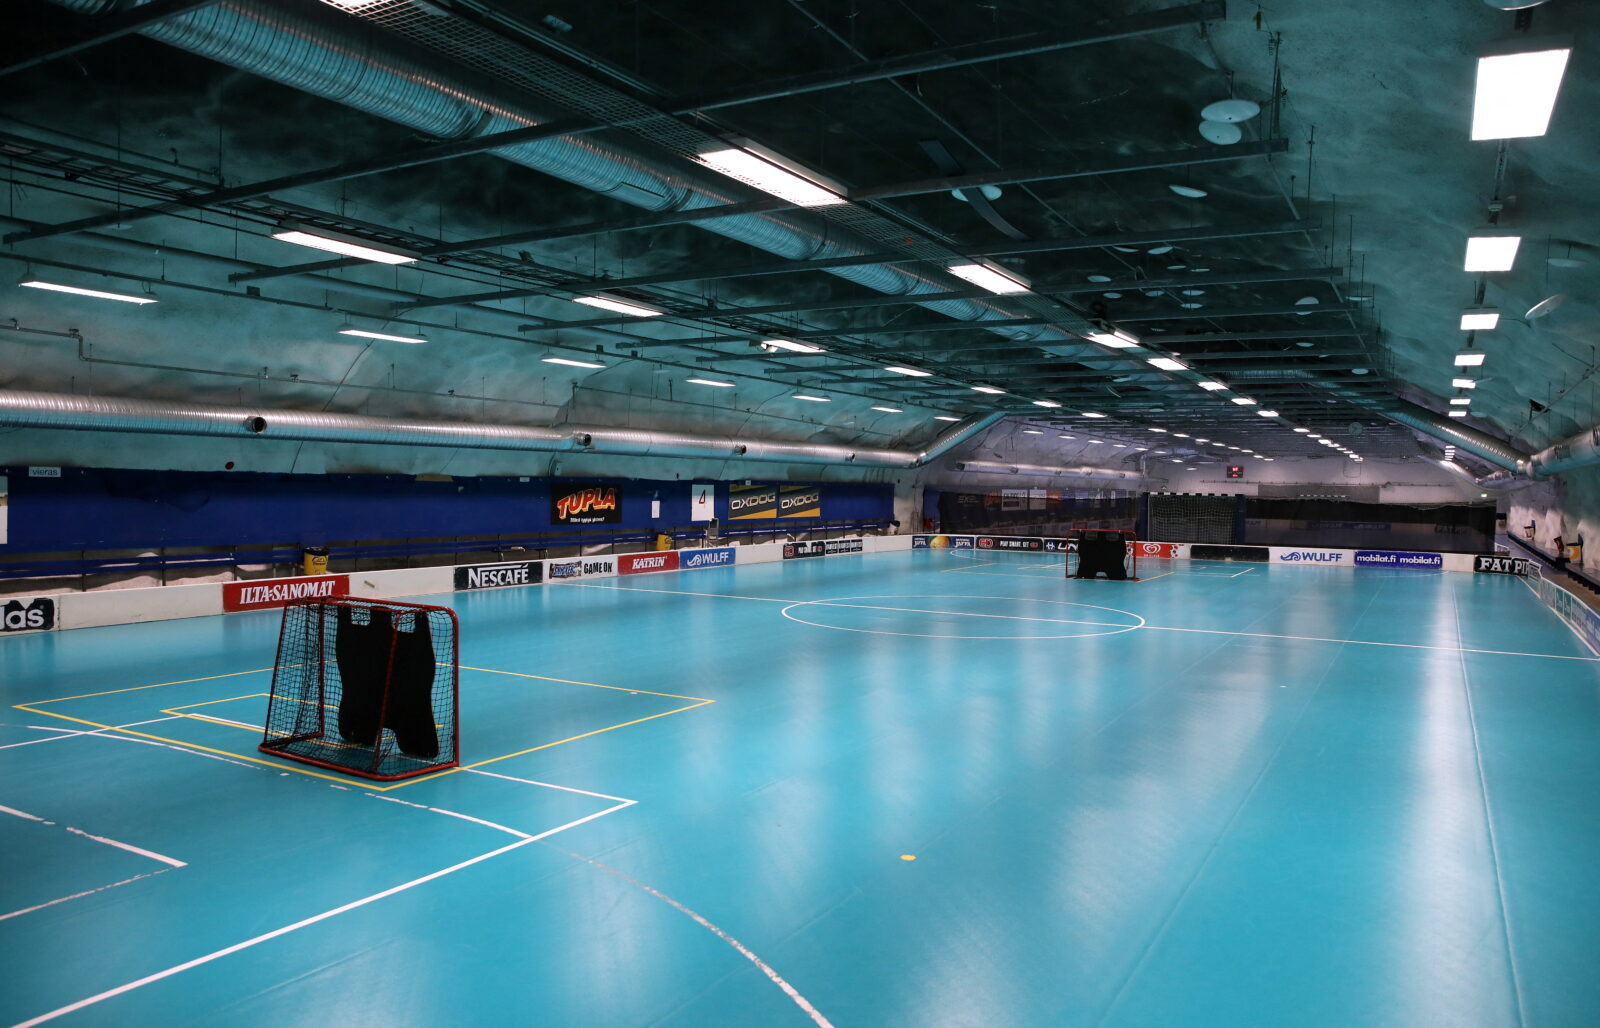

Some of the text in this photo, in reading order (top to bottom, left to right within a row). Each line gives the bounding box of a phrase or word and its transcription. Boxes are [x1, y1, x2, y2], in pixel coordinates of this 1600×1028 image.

[557, 488, 616, 520] TUPLA
[731, 492, 776, 510] OXDOG
[781, 492, 819, 509] OXDOG
[632, 557, 666, 570] KATRIN
[702, 551, 730, 564] WULFF
[1302, 552, 1343, 562] WULFF
[1357, 554, 1441, 565] mobilat.fi mobilat.fi
[583, 561, 613, 575] GAME ON
[1479, 557, 1512, 572] FAT
[467, 563, 529, 589] NESCAFÉ
